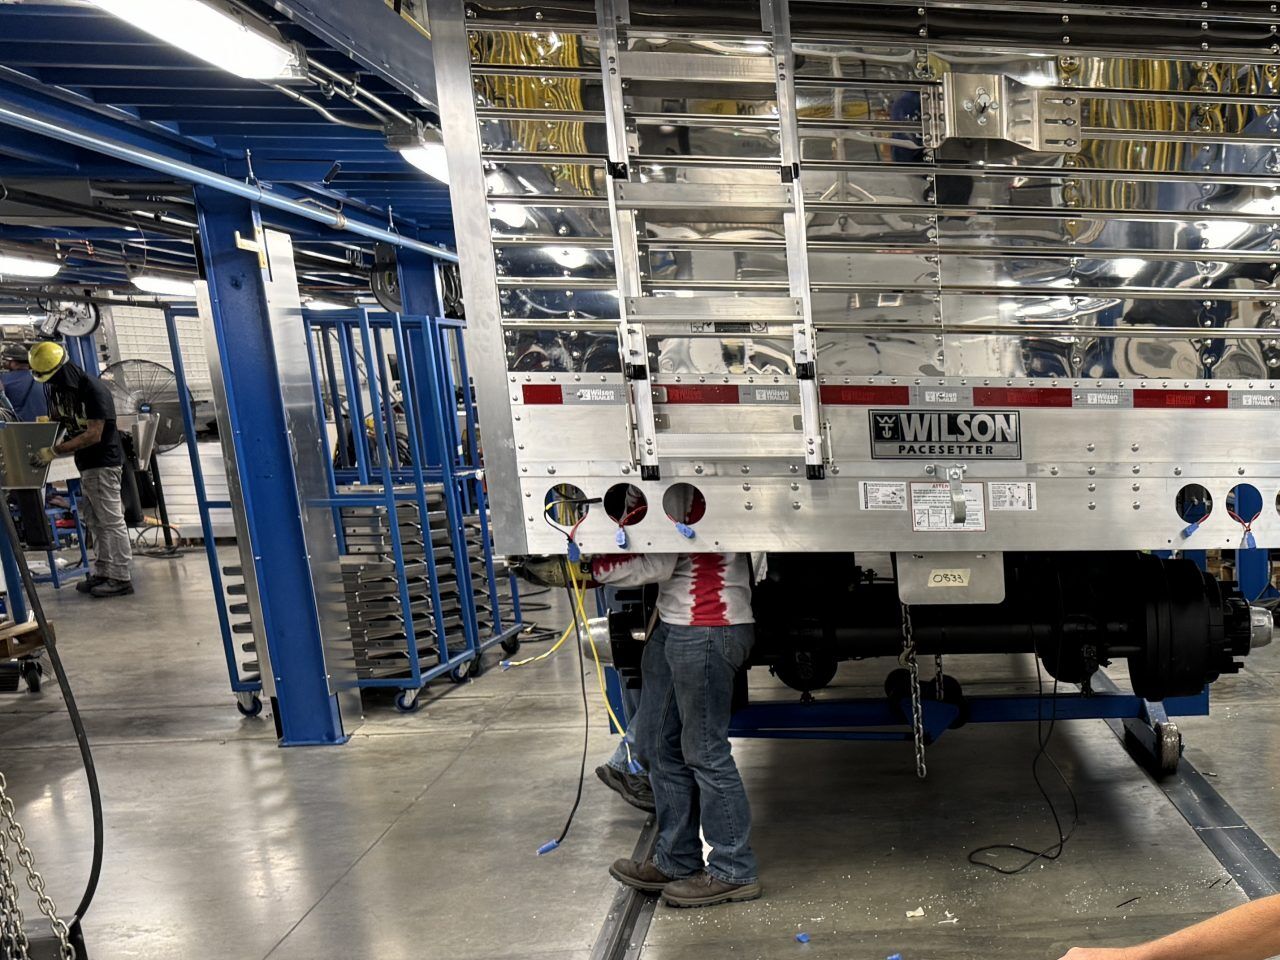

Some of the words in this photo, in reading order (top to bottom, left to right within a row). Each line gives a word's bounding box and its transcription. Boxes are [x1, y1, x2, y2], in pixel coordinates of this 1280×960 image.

[900, 414, 1016, 442] WILSON
[898, 445, 994, 454] PACESETTER
[932, 574, 964, 583] 0833
